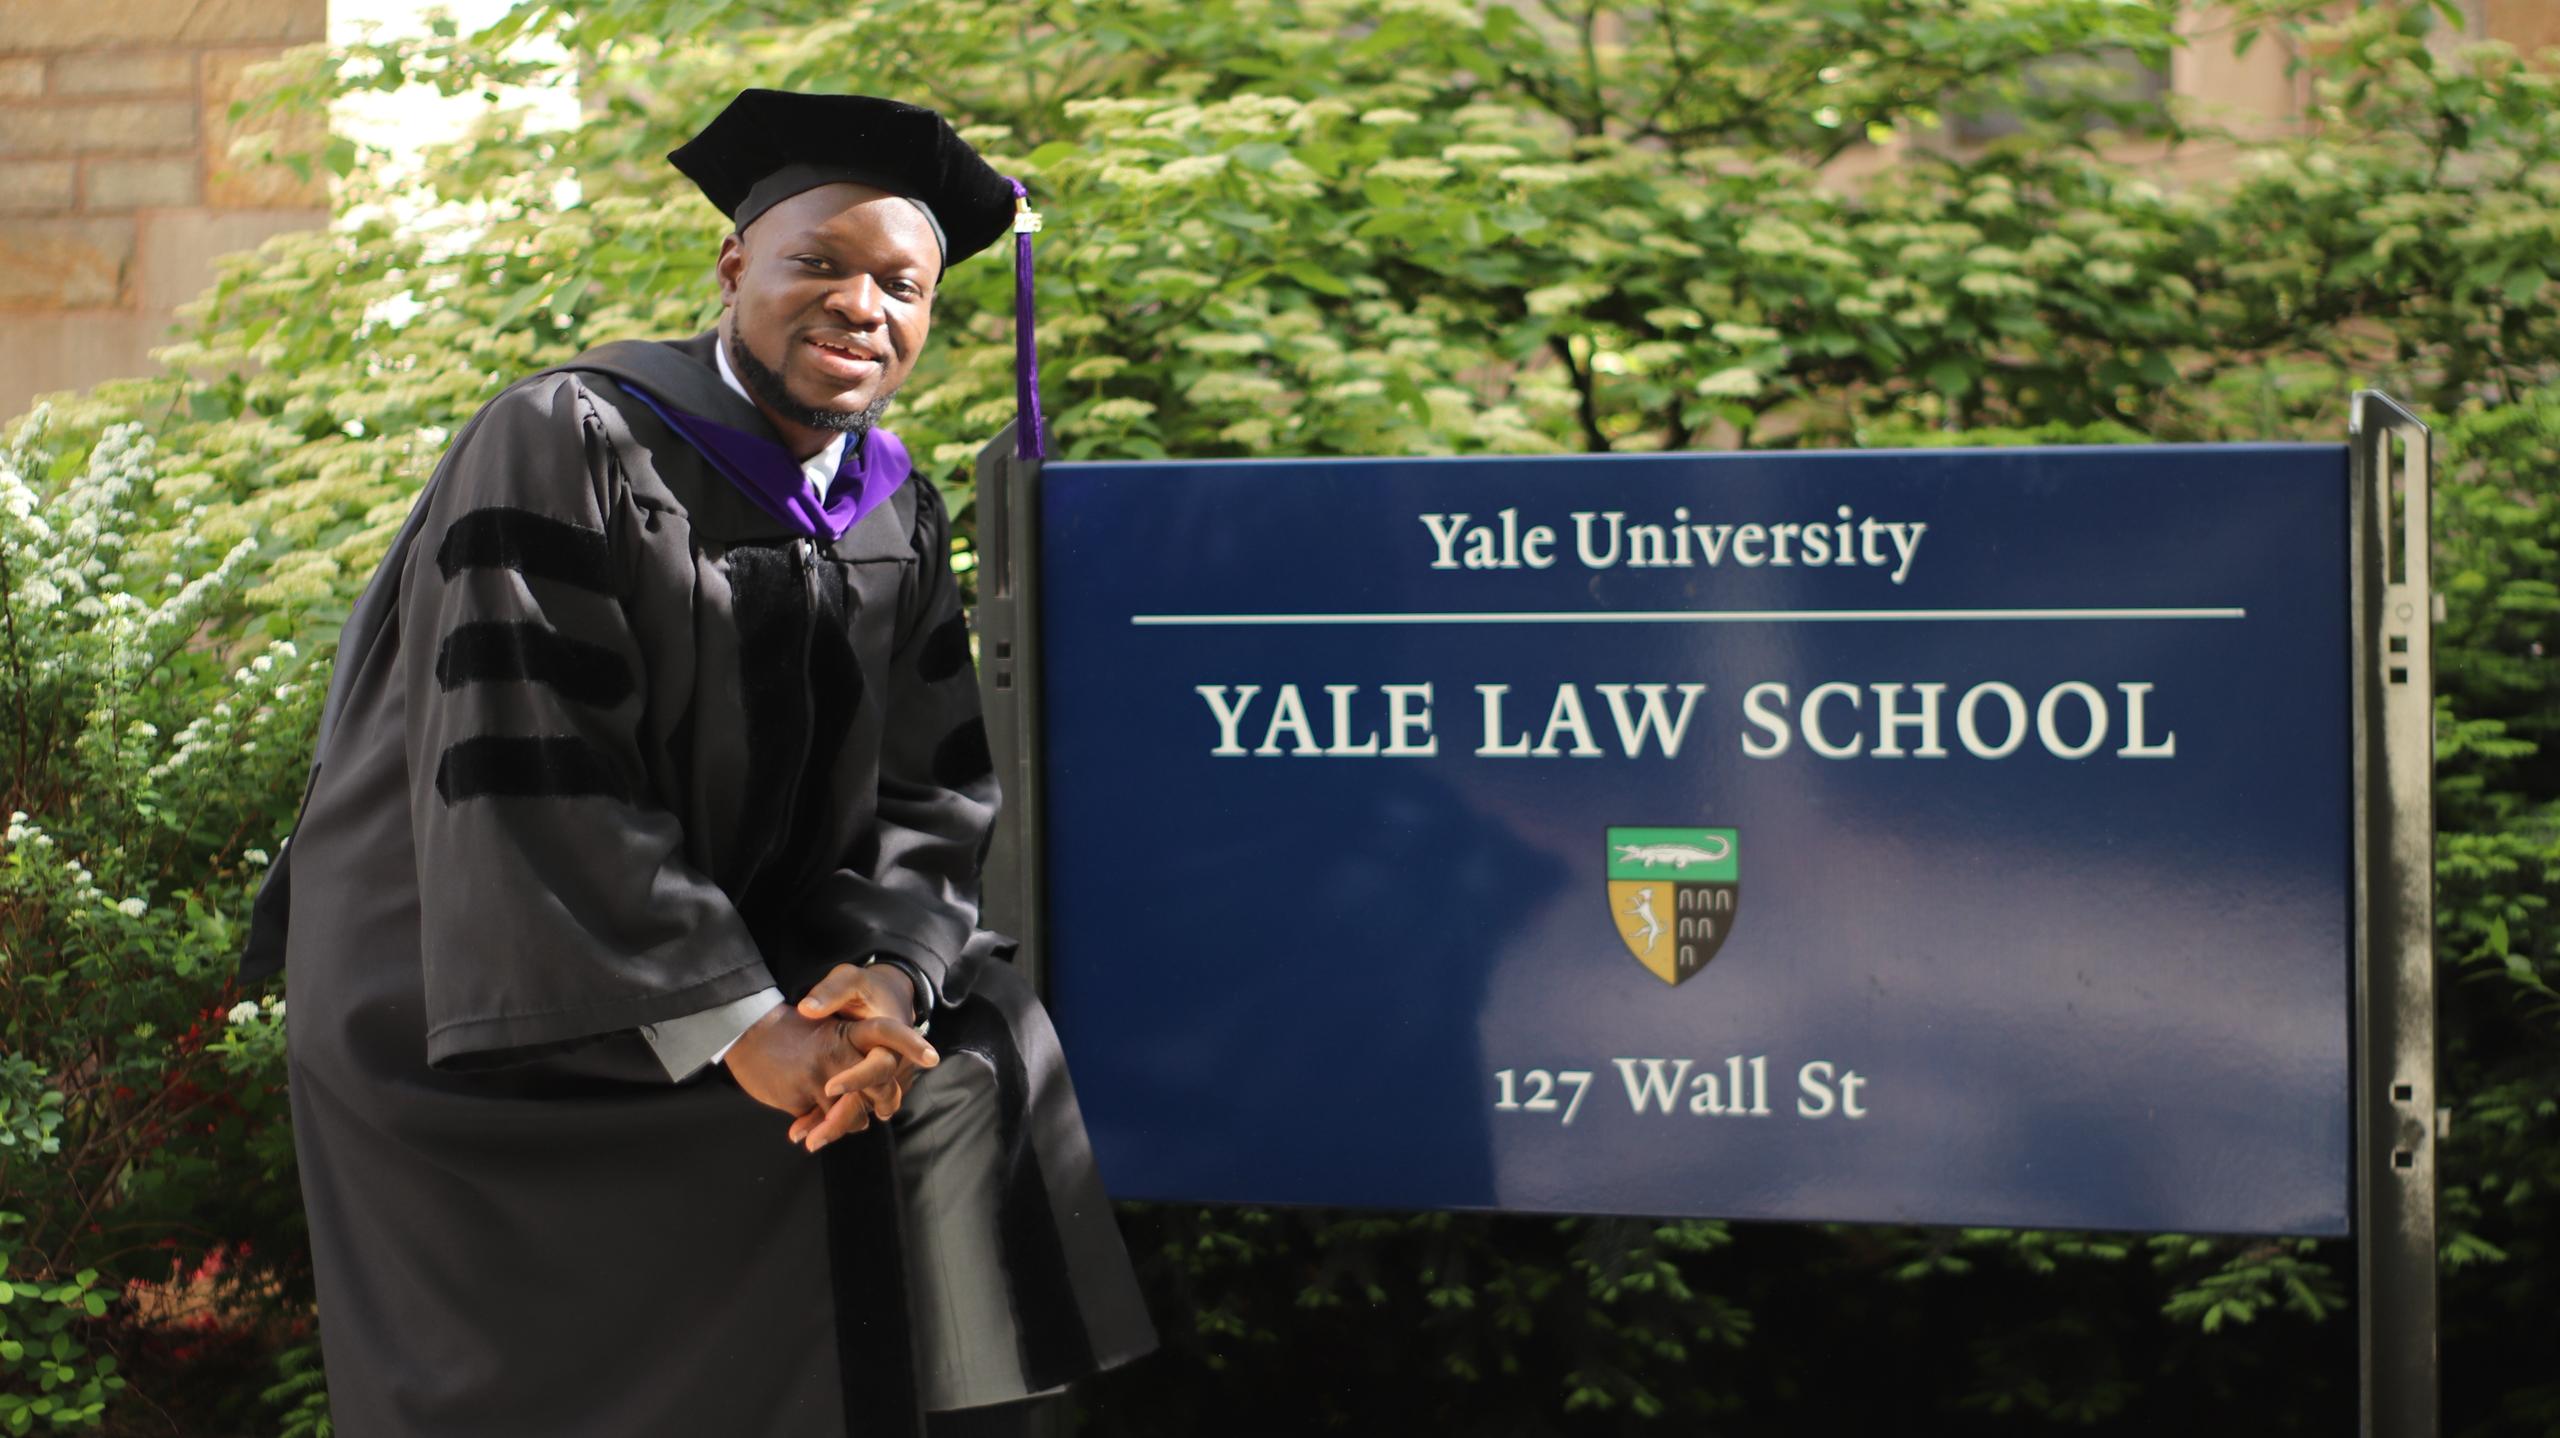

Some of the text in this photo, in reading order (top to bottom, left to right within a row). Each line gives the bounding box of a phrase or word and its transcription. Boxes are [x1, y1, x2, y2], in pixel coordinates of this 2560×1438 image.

[1420, 506, 1928, 584] Yale University
[1196, 682, 2176, 760] YALE LAW SCHOOL
[1495, 1054, 1867, 1125] 127 Wall St
